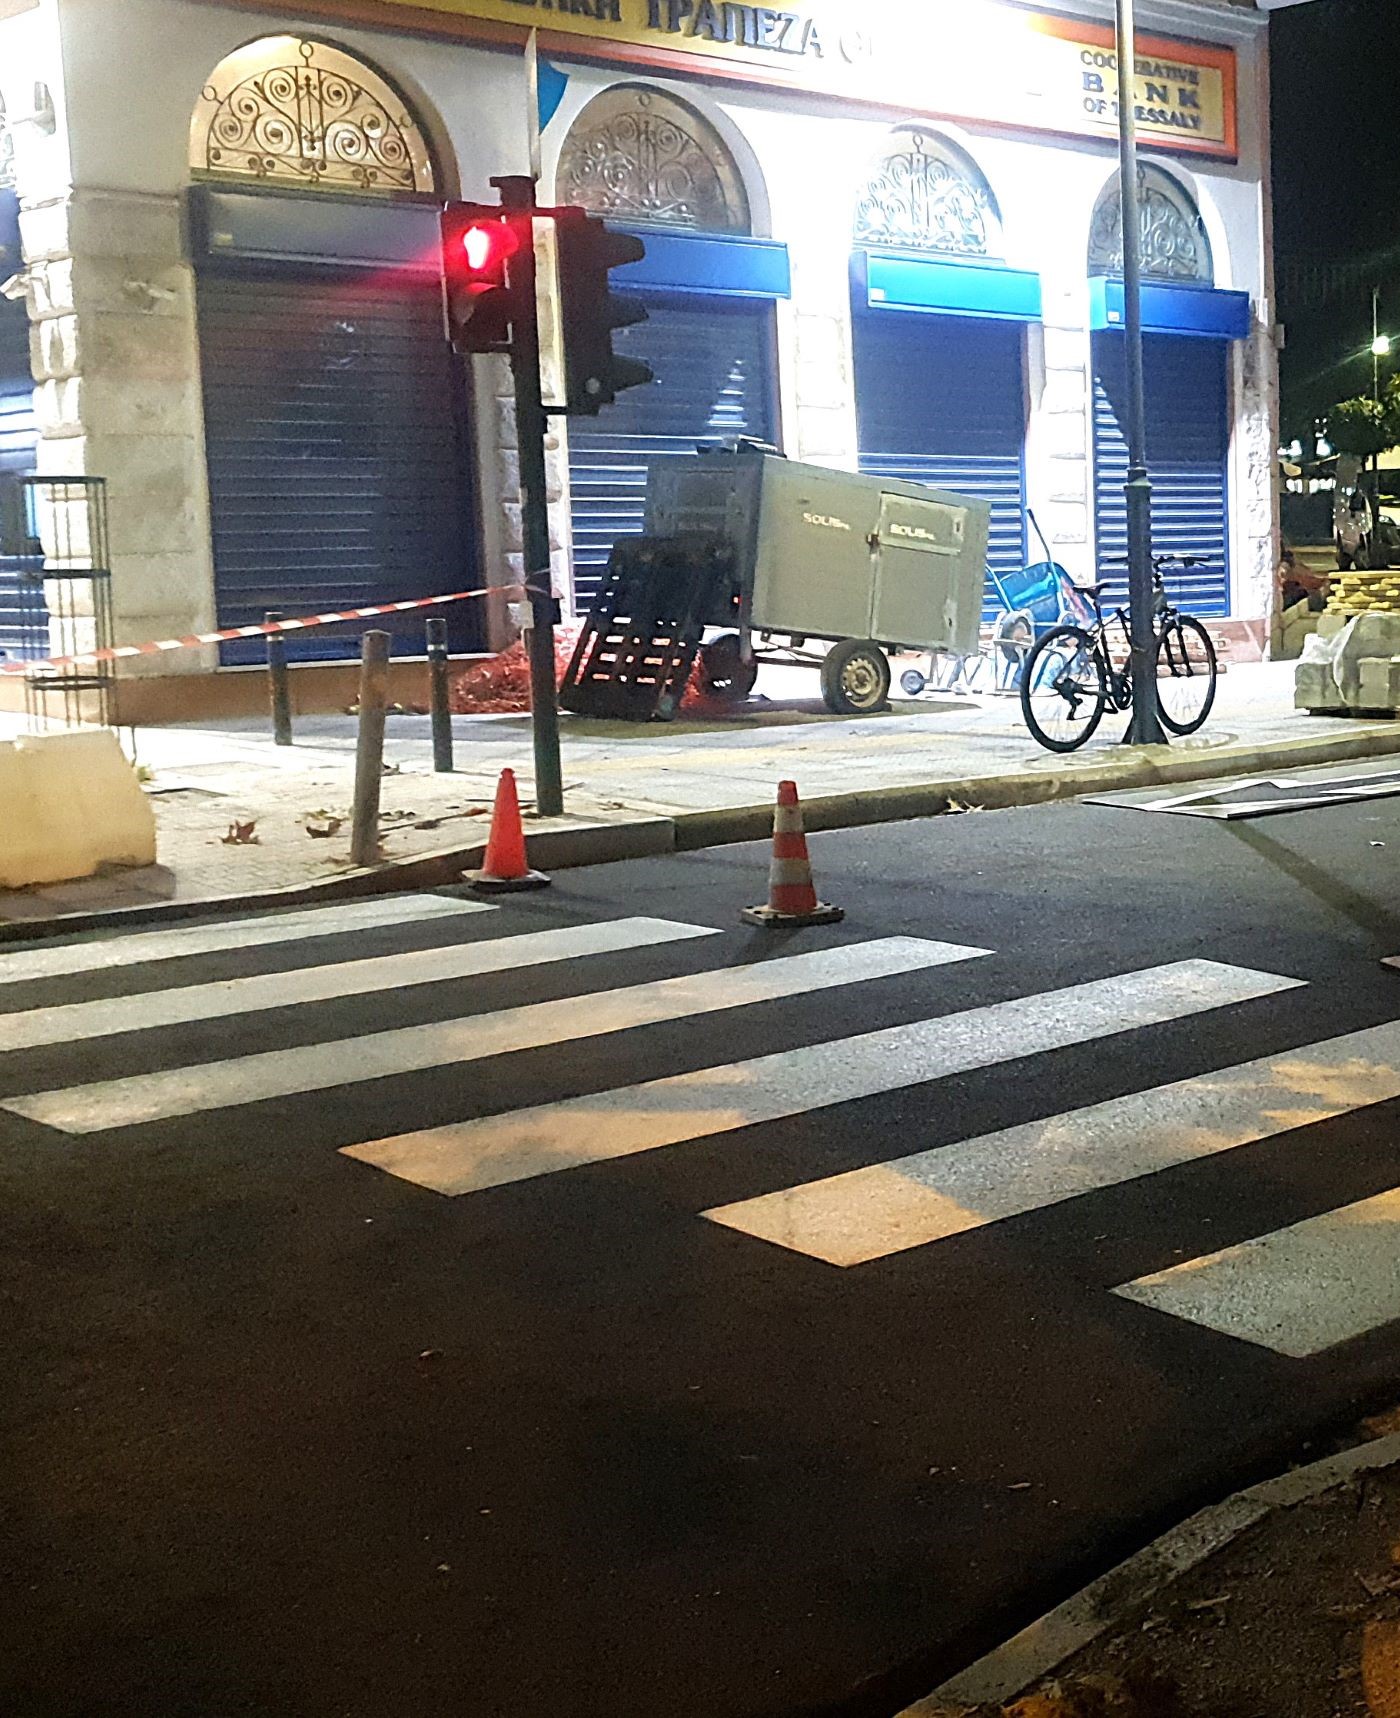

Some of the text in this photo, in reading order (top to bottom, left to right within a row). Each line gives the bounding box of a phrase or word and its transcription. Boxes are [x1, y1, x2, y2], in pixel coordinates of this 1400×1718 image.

[1081, 71, 1201, 109] BNK
[1082, 97, 1202, 131] OF TESSALY
